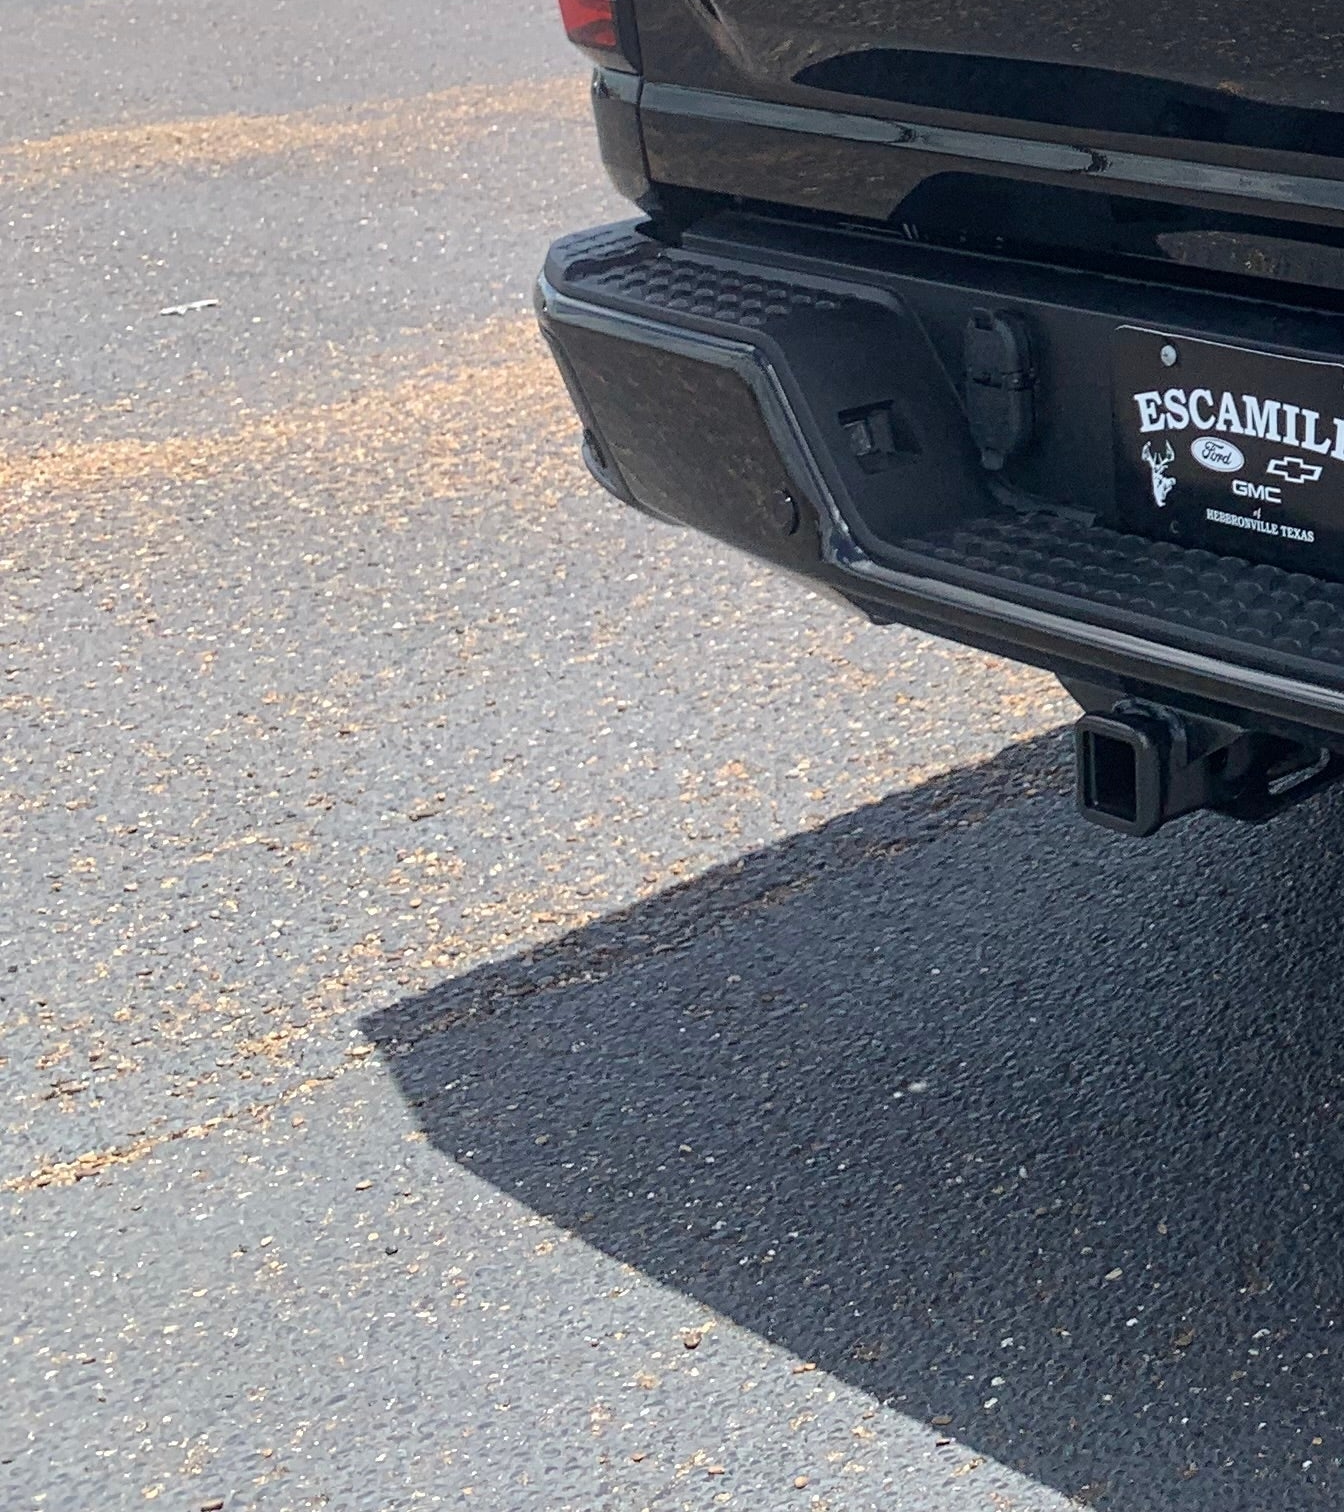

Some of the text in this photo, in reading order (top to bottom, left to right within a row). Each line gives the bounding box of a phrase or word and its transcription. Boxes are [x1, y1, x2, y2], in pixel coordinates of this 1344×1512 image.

[1231, 479, 1282, 504] GMC
[1206, 508, 1315, 543] HEBBRONVILLE TEXAS
